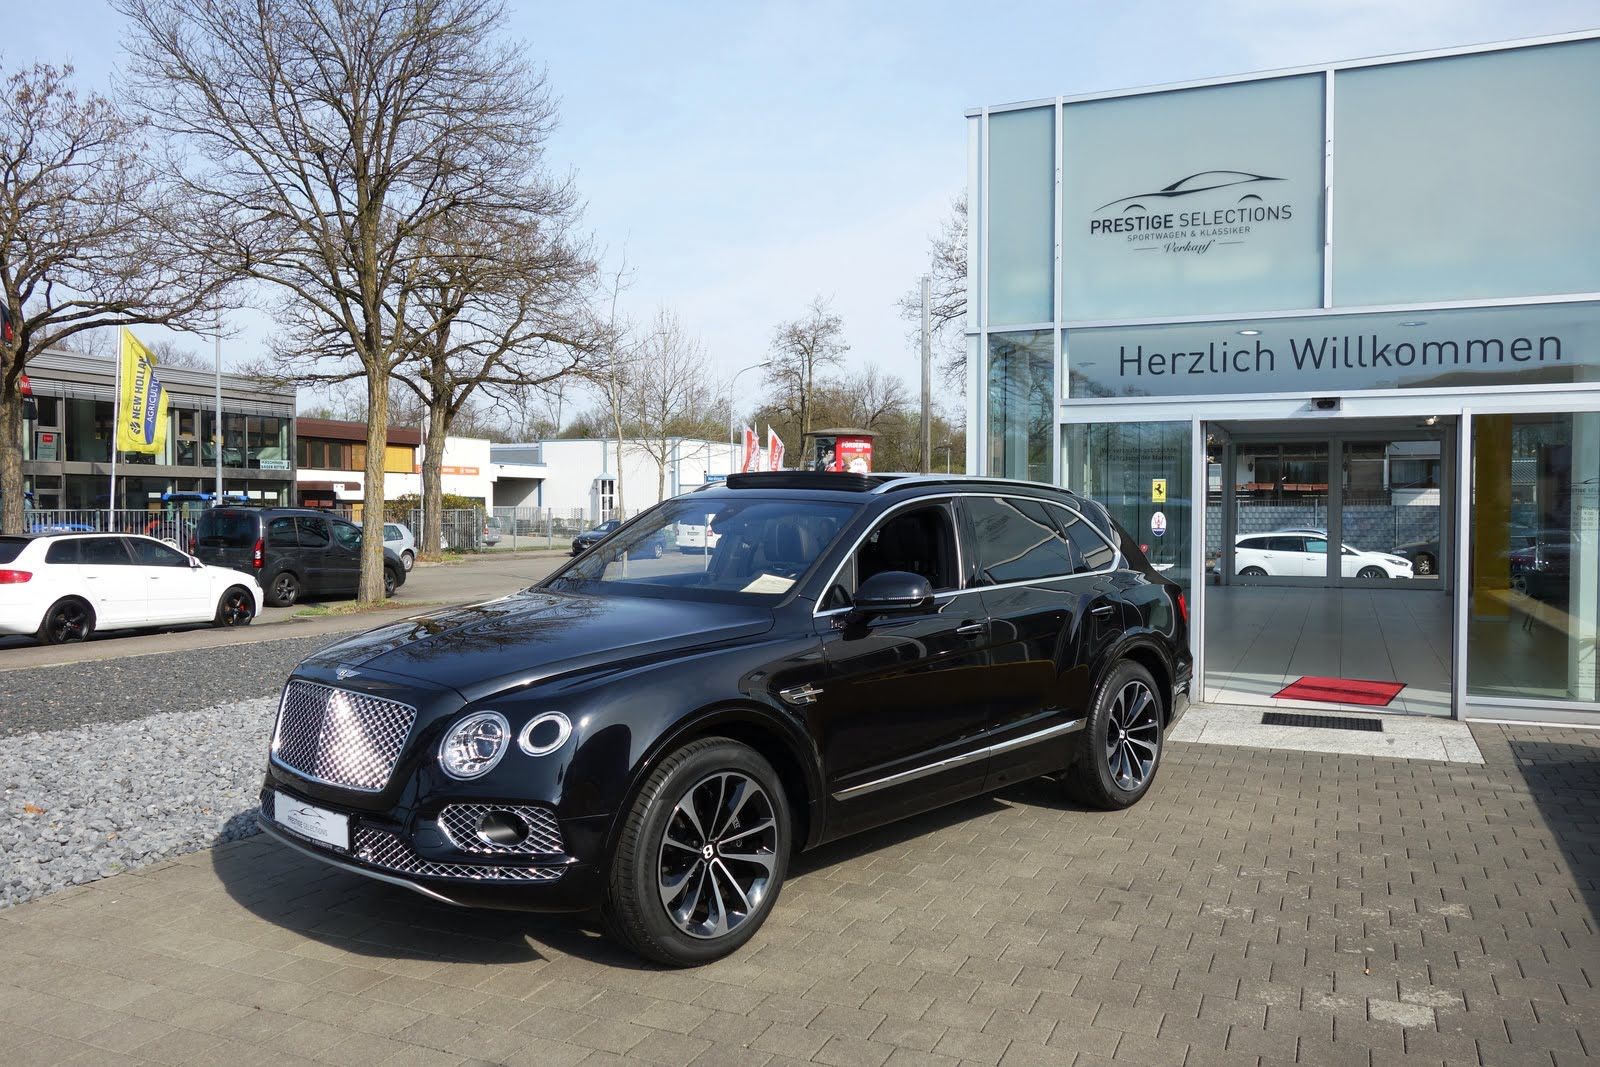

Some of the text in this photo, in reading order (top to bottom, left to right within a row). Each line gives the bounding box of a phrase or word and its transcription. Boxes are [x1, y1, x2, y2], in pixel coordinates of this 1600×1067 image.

[1090, 204, 1293, 235] PRESTIGE SELECTIONS
[1127, 226, 1251, 242] SPORTWAGEN & KLASSIKER
[1163, 239, 1216, 254] Verkauf
[1119, 335, 1562, 376] Herzlich Willkommen
[132, 355, 147, 419] NEW HOLLAN
[146, 374, 159, 423] AGRICULTU
